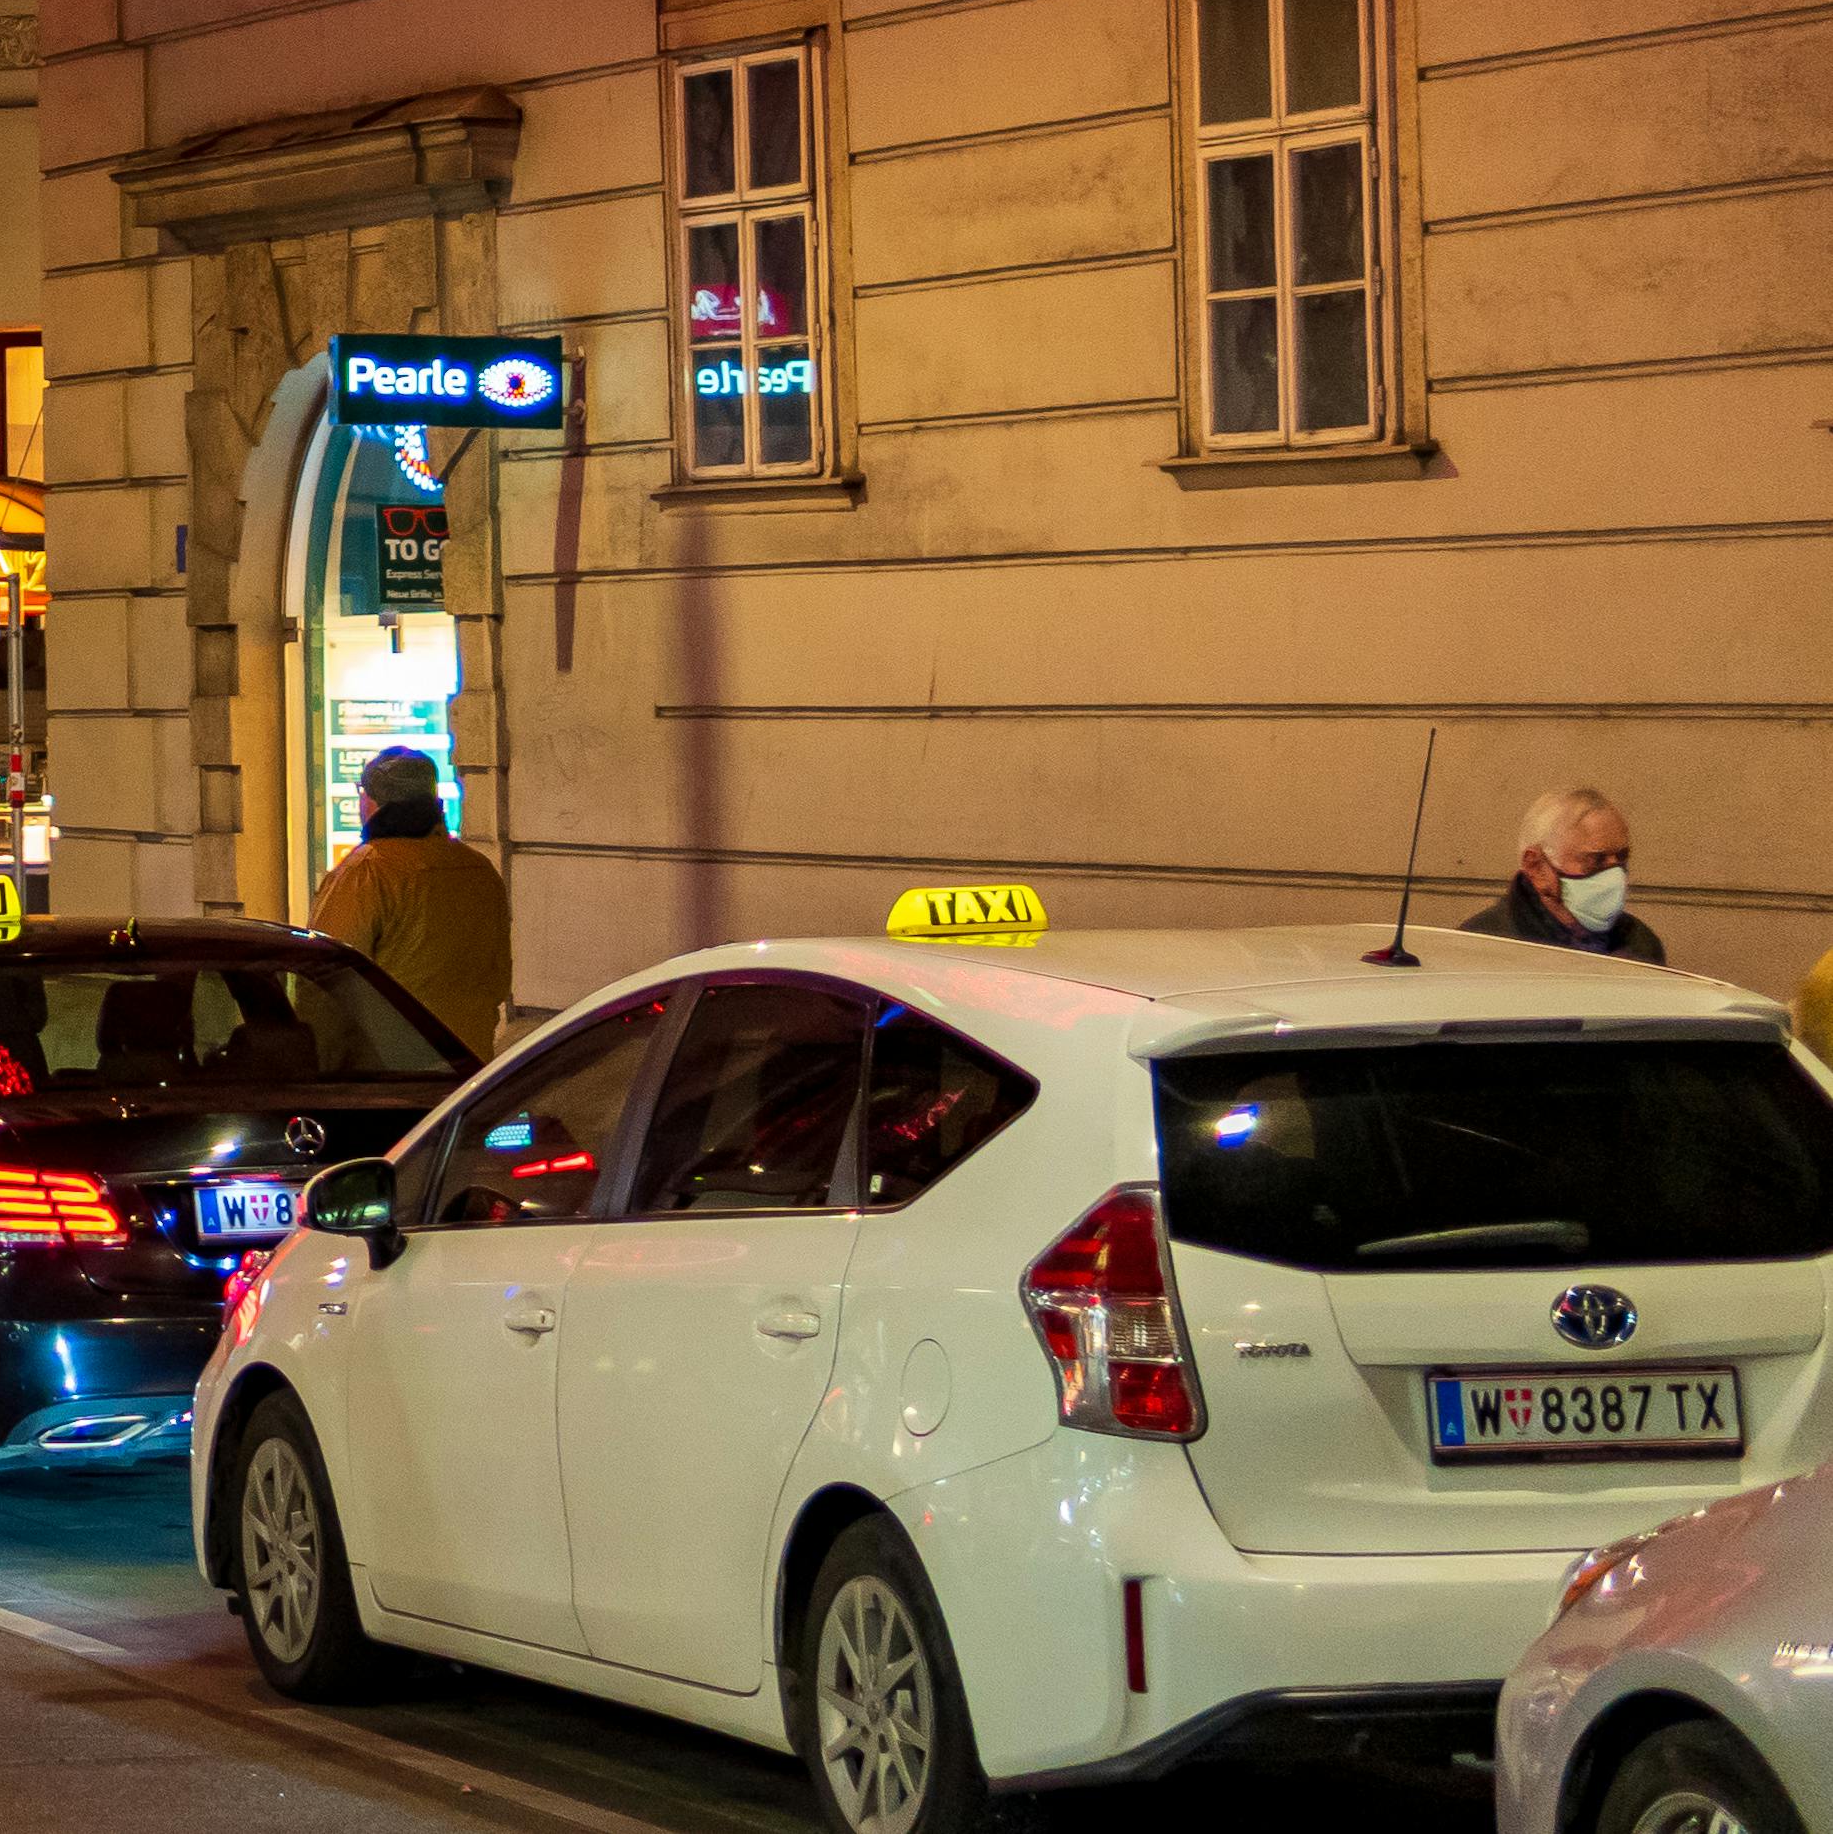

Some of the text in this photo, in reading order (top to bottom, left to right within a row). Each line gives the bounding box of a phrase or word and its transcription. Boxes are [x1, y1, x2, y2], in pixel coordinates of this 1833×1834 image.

[347, 356, 467, 395] Pearle
[384, 539, 418, 561] TO
[927, 890, 1030, 925] TAXI
[222, 1195, 246, 1227] W
[1470, 1388, 1501, 1437] W
[1540, 1384, 1652, 1435] 8387
[1666, 1382, 1725, 1431] TX
